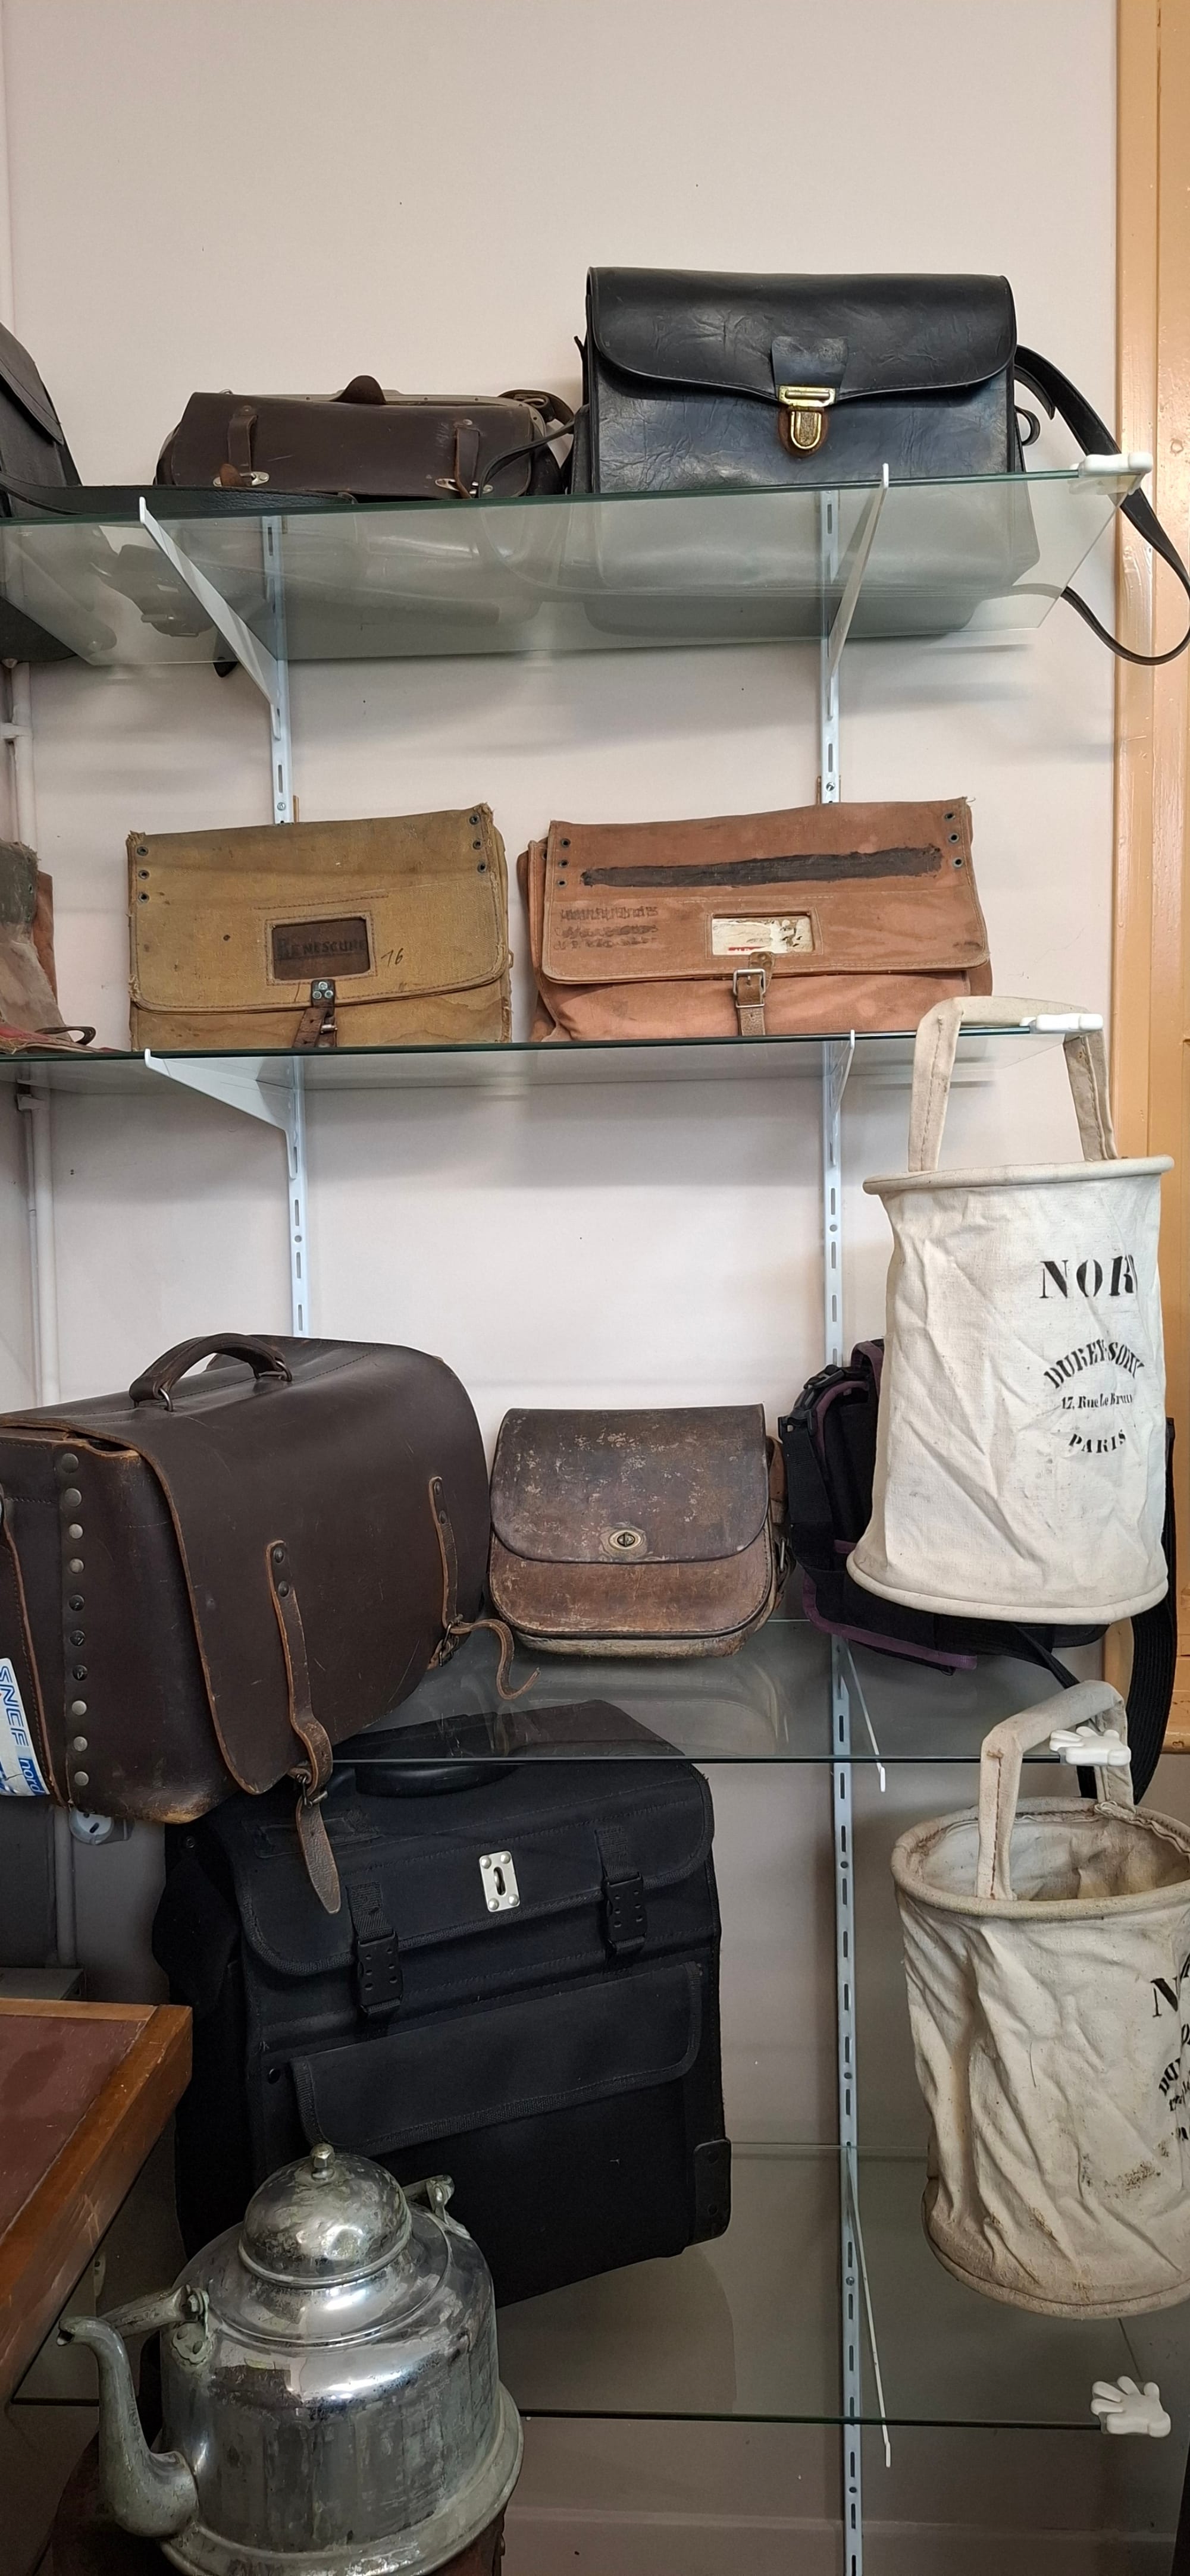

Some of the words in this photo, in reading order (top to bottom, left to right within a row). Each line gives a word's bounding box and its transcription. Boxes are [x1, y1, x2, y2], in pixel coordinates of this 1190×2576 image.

[1078, 1395, 1098, 1408] Rue
[1069, 1429, 1126, 1453] PARIS
[0, 1666, 29, 1747] SNCF
[20, 1758, 45, 1795] nord
